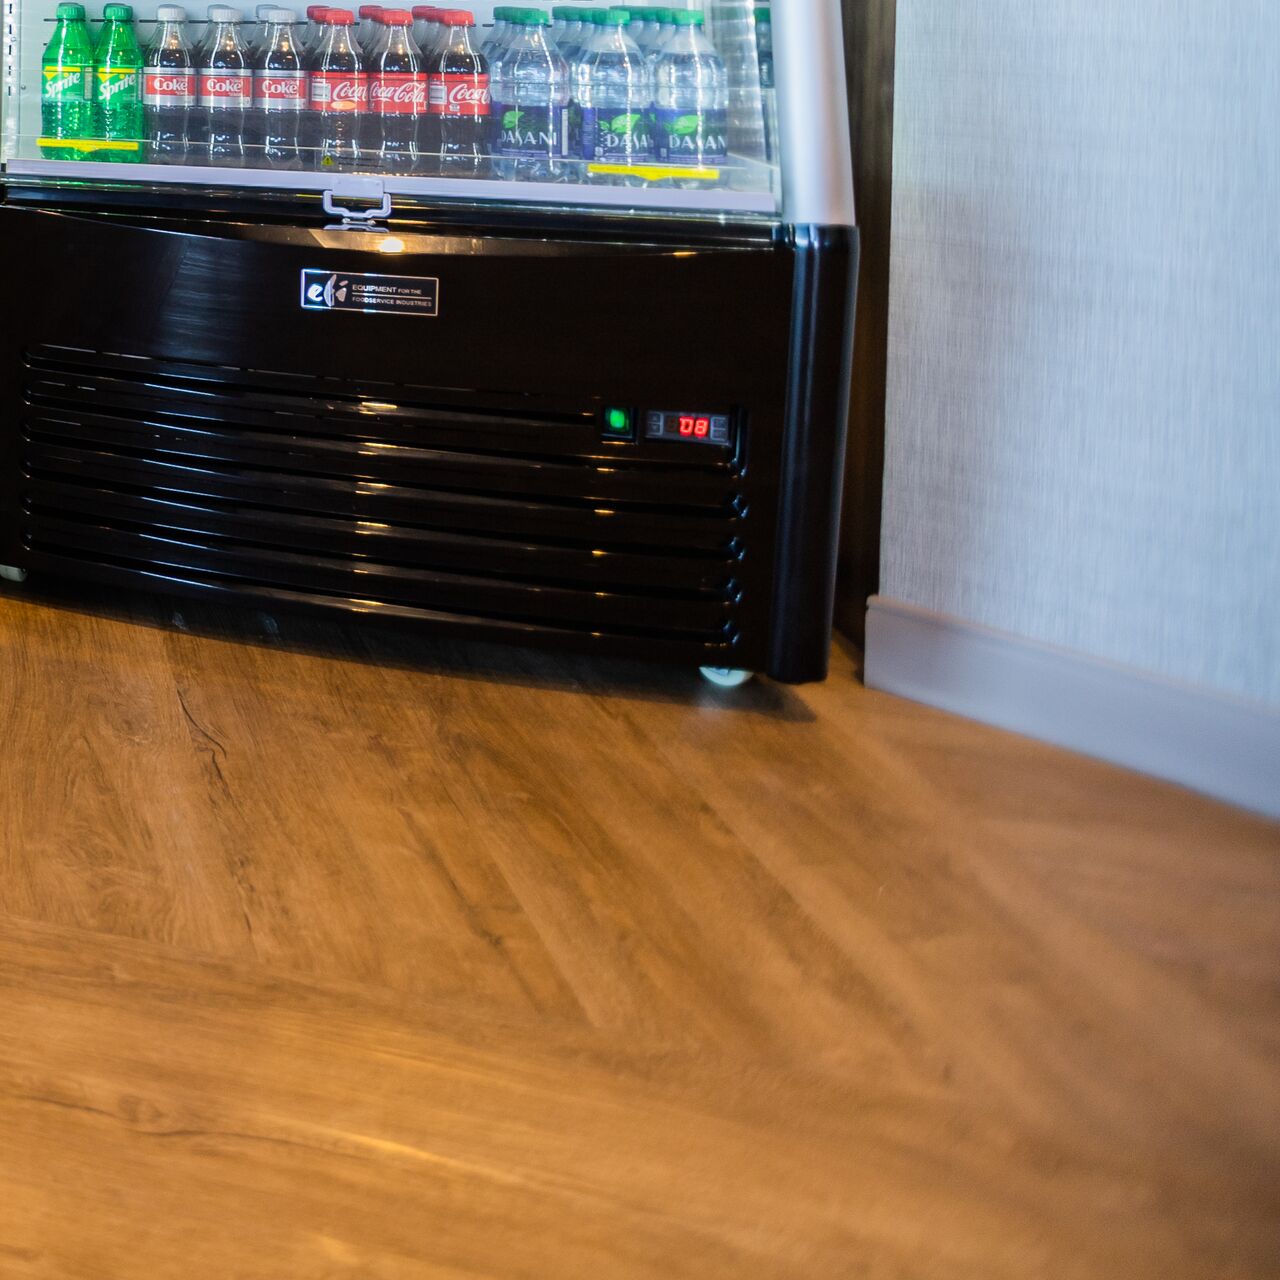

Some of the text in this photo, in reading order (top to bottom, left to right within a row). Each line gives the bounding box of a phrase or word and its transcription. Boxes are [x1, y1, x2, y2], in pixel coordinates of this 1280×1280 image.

[45, 72, 80, 98] Sprite
[98, 73, 135, 100] Sprite
[153, 77, 188, 91] Coke
[206, 78, 242, 93] Coke
[262, 79, 298, 94] Coke
[501, 129, 558, 146] DASANI
[352, 283, 397, 294] EQUIPMENT
[351, 296, 432, 307] FOODSERVICE INDUSTRIES
